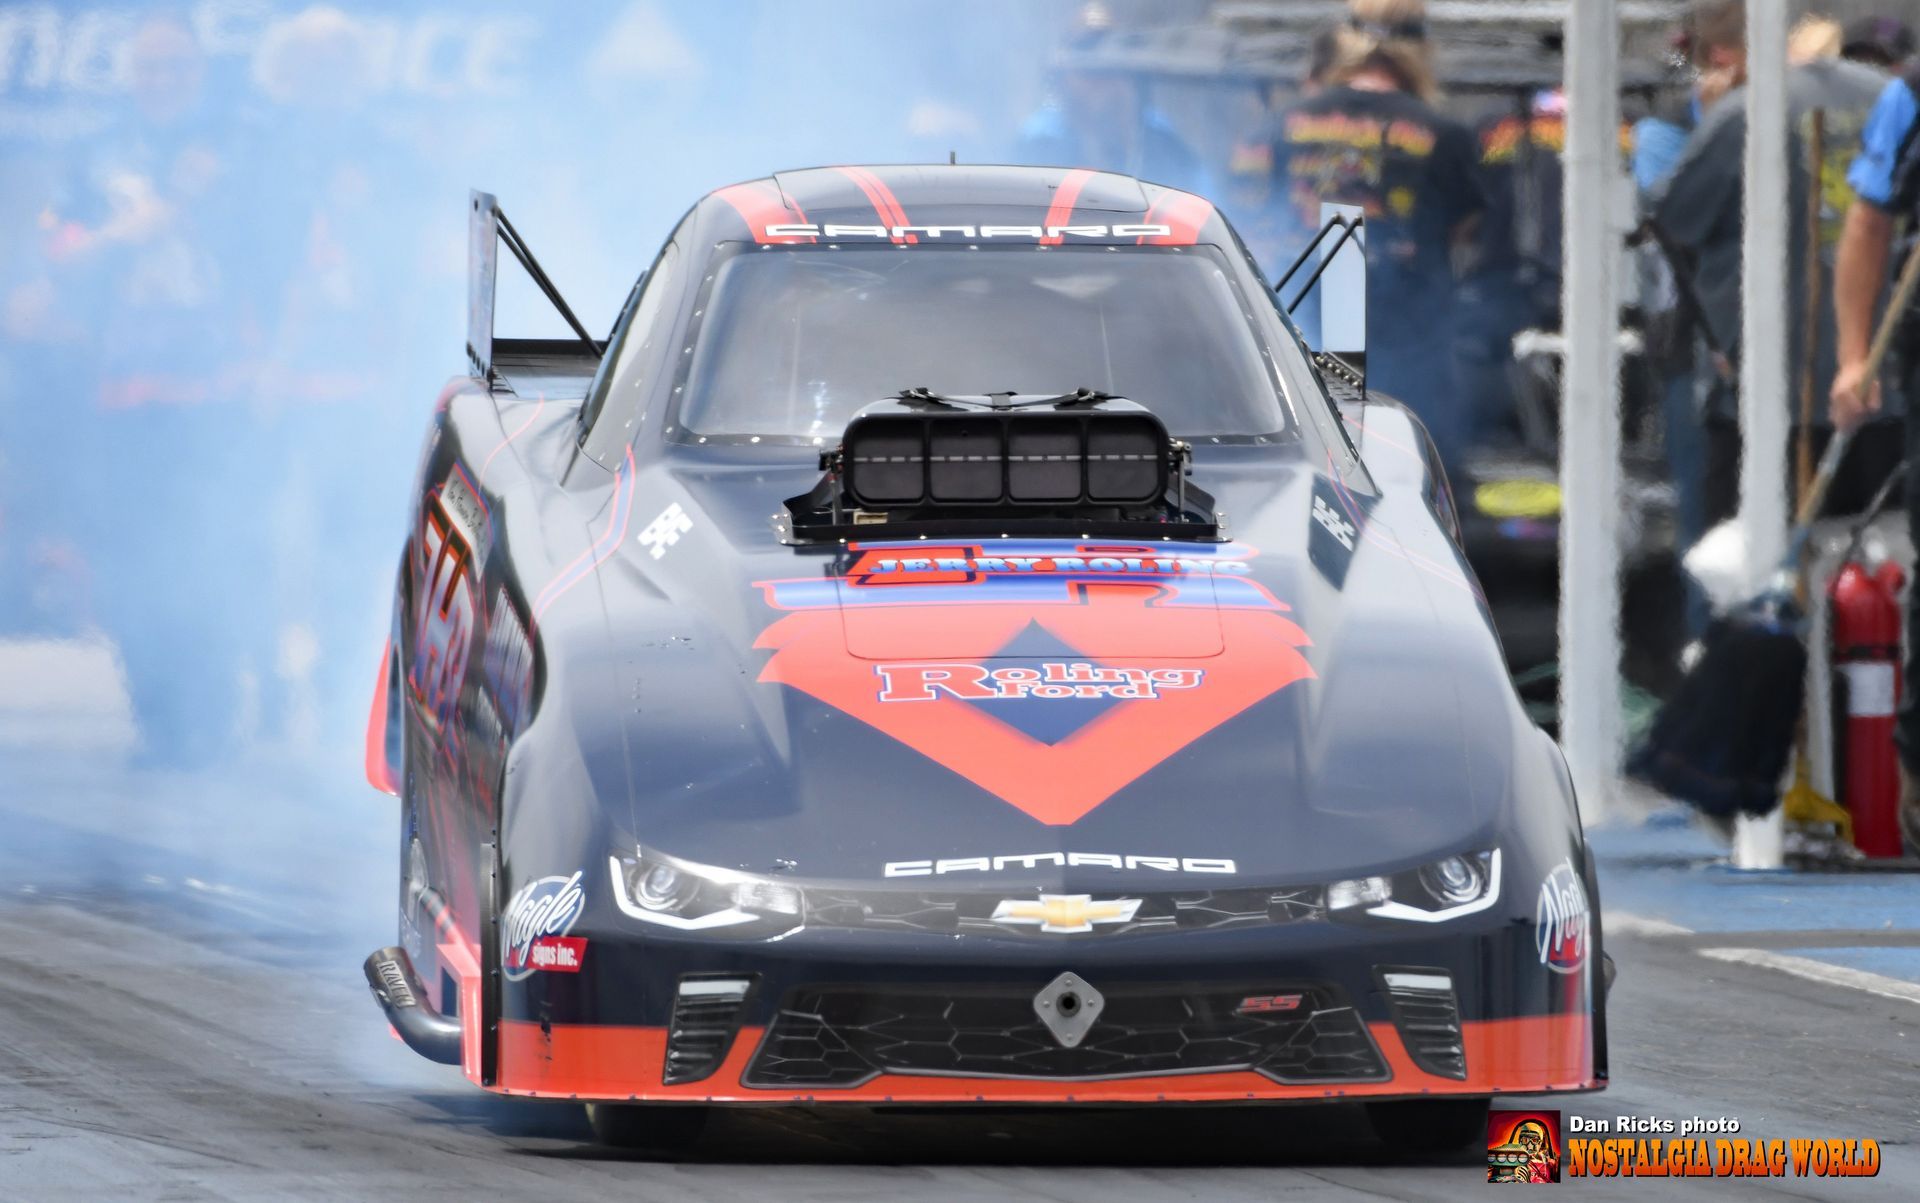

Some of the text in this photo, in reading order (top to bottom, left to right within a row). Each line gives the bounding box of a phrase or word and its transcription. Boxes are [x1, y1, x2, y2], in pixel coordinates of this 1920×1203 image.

[764, 224, 1171, 239] CAMARO
[868, 557, 1252, 576] JERRY ROLING
[873, 663, 1205, 702] Roling
[996, 679, 1159, 699] Ford
[884, 851, 1237, 878] CAMARO
[531, 942, 557, 967] signs
